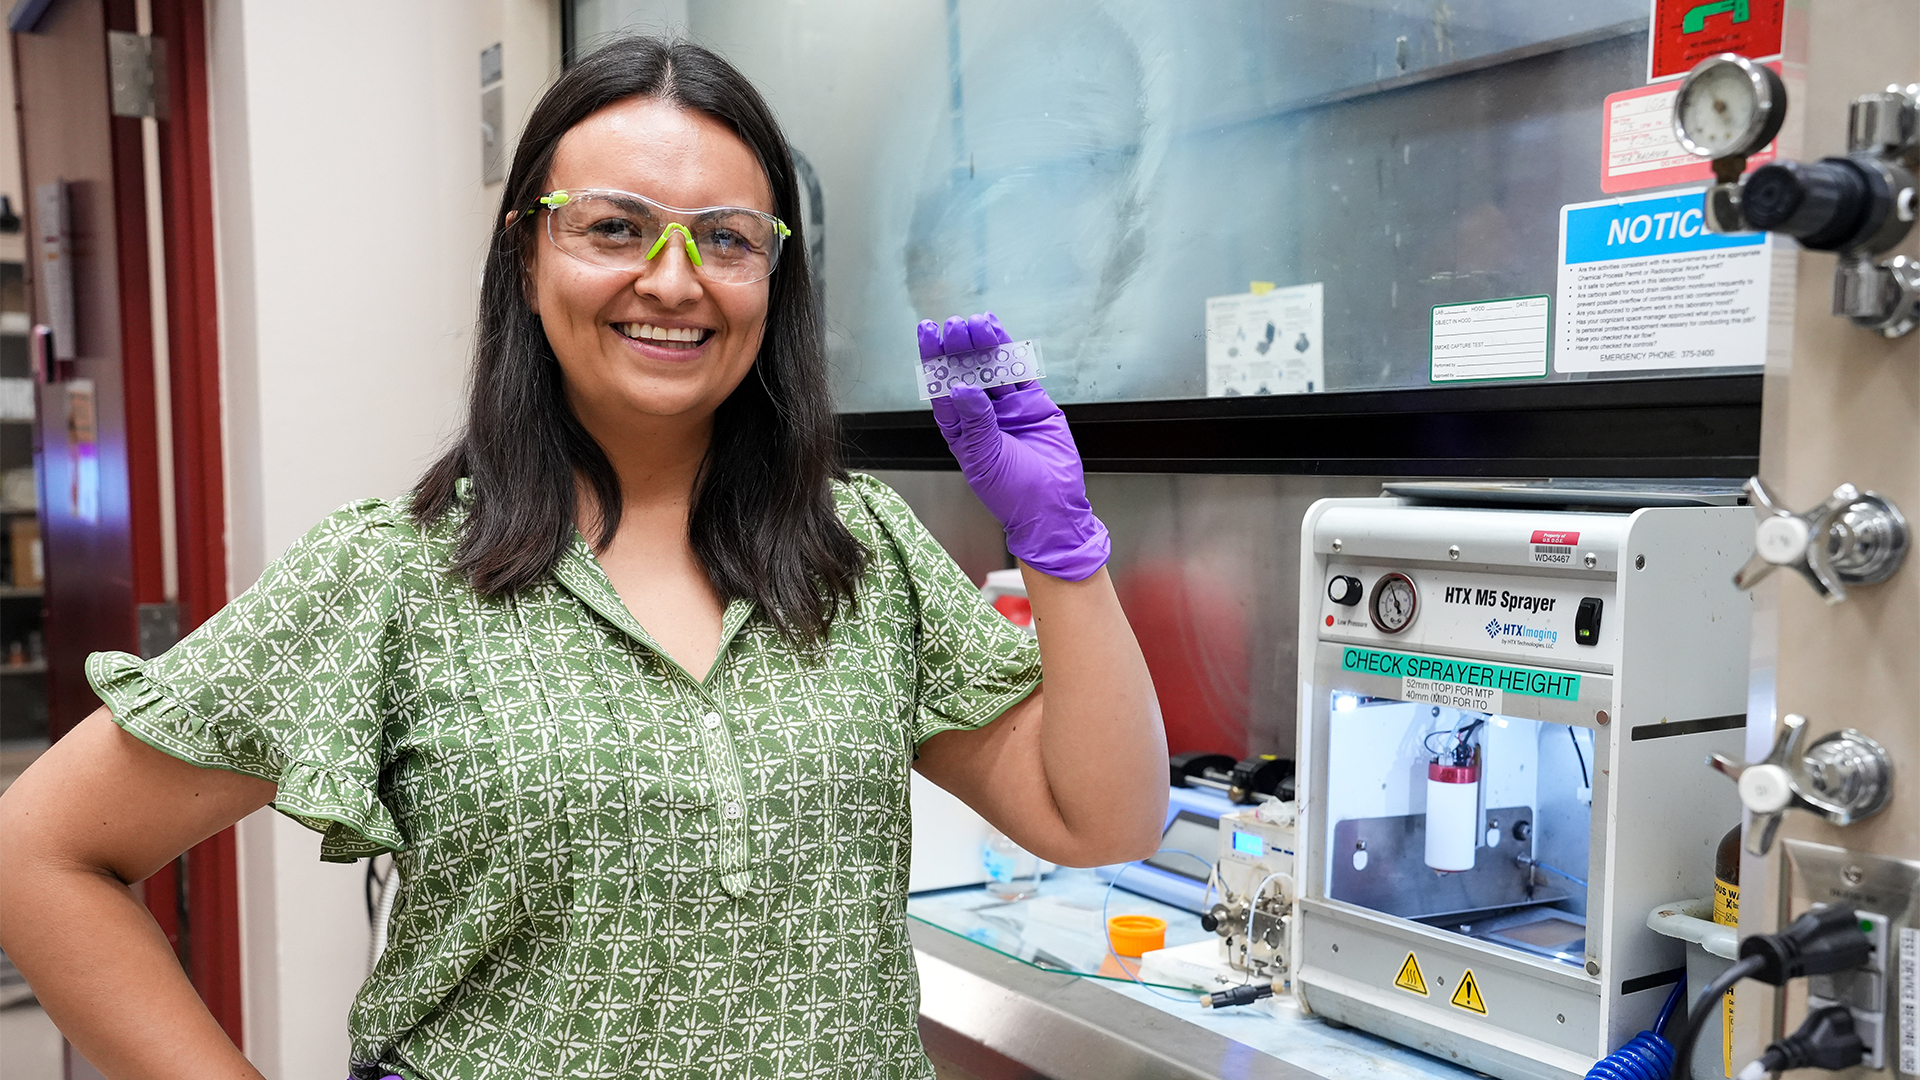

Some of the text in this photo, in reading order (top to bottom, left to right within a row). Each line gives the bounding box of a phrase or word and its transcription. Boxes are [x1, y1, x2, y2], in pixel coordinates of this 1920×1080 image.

[1671, 158, 1685, 166] NOT
[1621, 261, 1648, 269] consistent
[1695, 289, 1739, 298] contamination?
[1600, 316, 1624, 324] cognizant
[1730, 307, 1749, 315] doing?
[1435, 318, 1452, 326] OBJECT
[1600, 349, 1714, 362] EMERGENCY PHONE: 375-2400
[1534, 554, 1570, 563] WD43467
[1445, 586, 1556, 614] HTX M5 Sprayer
[1347, 620, 1368, 628] Pressure
[1345, 650, 1576, 696] CHECK SPRAYER HEIGHT
[1406, 680, 1494, 698] 52mm (TOP) FOR MTP
[1406, 691, 1488, 710] 40mm (MID) FOR ITO
